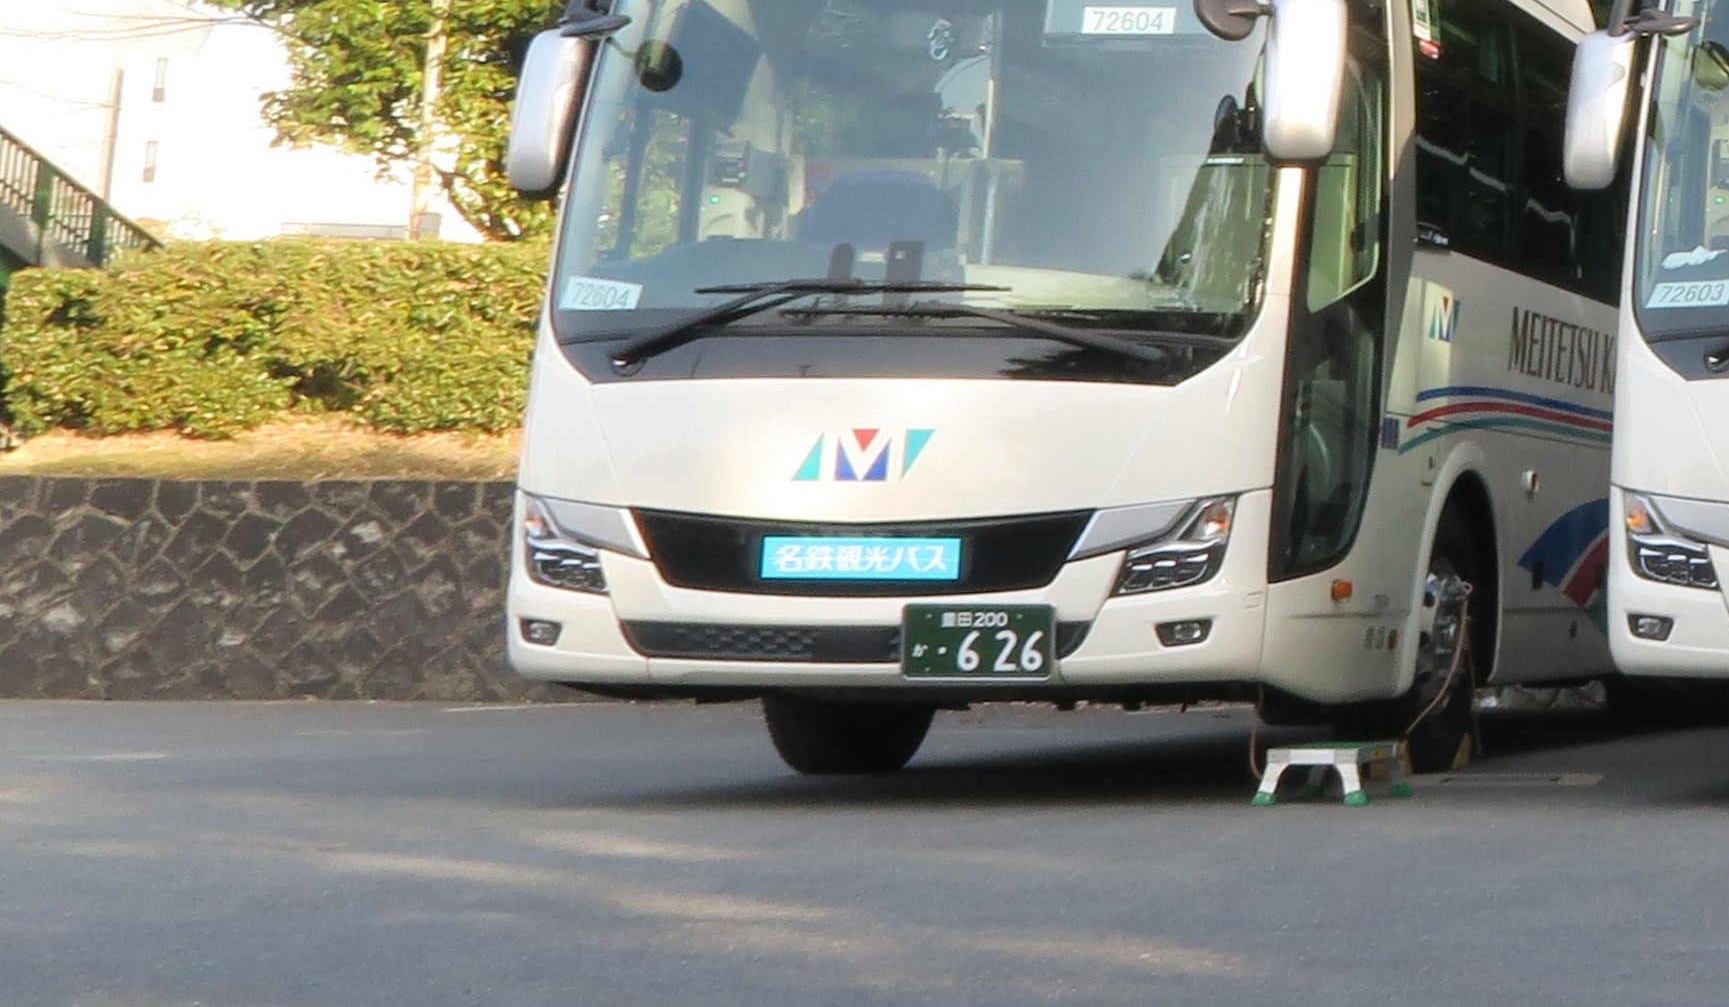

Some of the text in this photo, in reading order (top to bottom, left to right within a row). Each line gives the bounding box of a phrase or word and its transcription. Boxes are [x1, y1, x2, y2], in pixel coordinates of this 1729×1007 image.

[1092, 11, 1164, 31] 72604
[571, 282, 630, 308] 72604
[1659, 283, 1725, 303] 72603
[1508, 306, 1600, 390] MEITETSU
[775, 544, 947, 573] 名鉄観光バス
